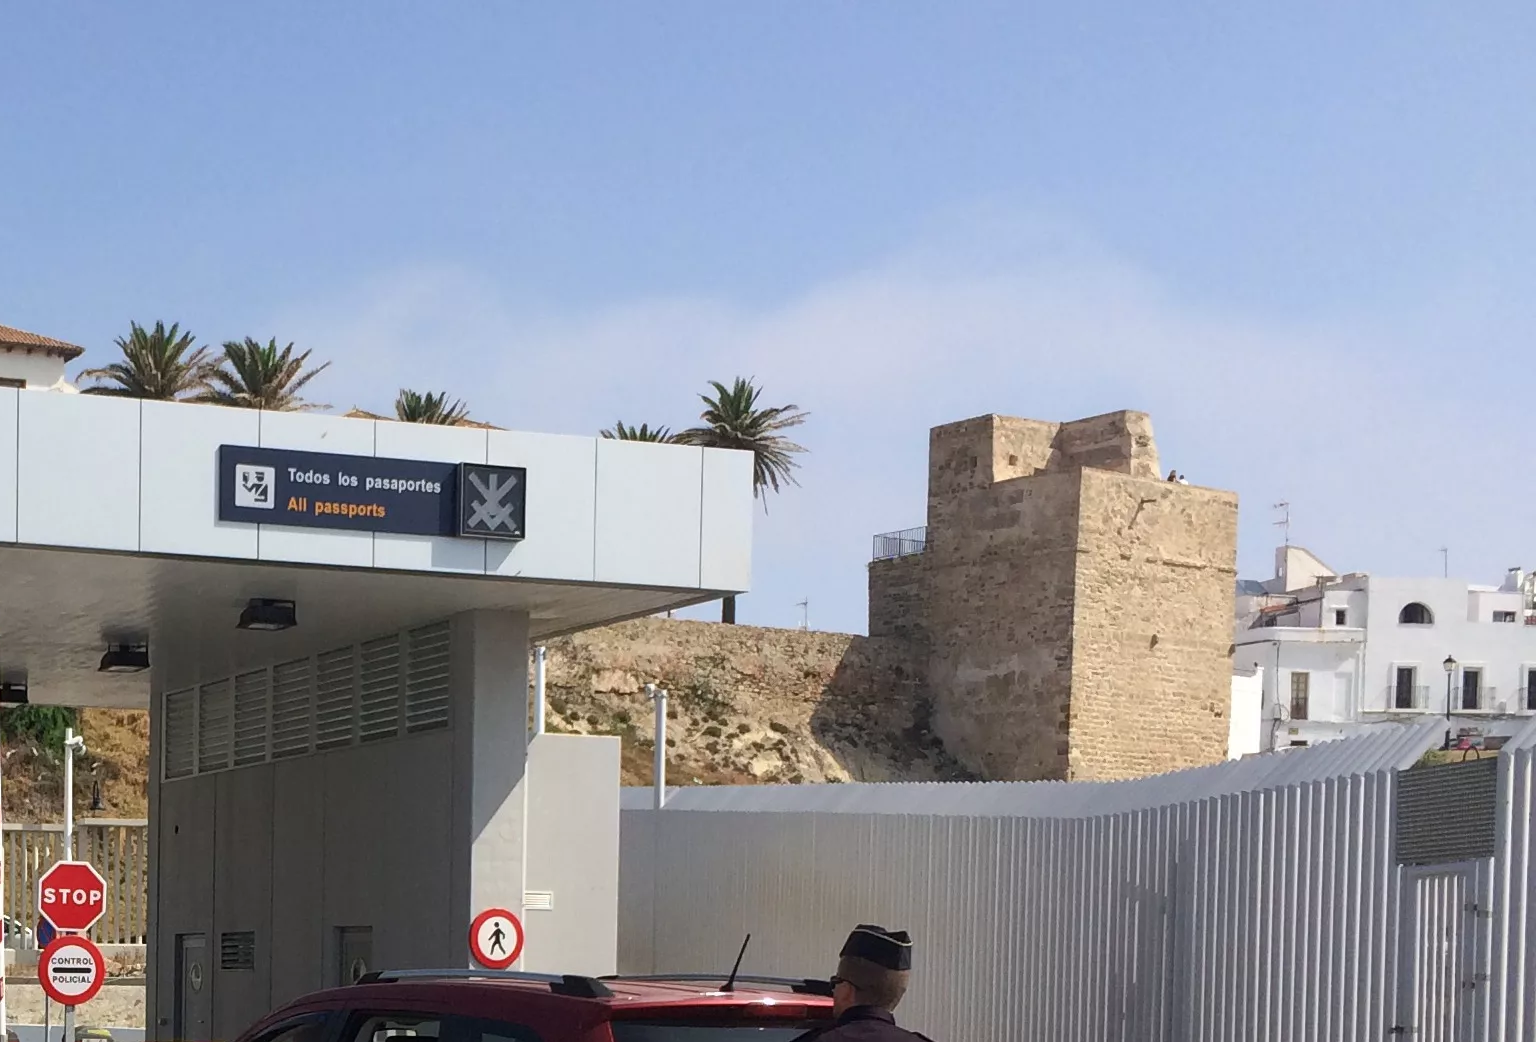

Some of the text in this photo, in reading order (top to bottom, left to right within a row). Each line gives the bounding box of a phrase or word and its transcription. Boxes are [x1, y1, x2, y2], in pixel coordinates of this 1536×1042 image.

[287, 467, 442, 494] Todos los pasaportes
[287, 496, 386, 518] All passports
[43, 888, 102, 906] STOP
[51, 957, 94, 966] CONTROL
[52, 975, 92, 984] POLICIAL
